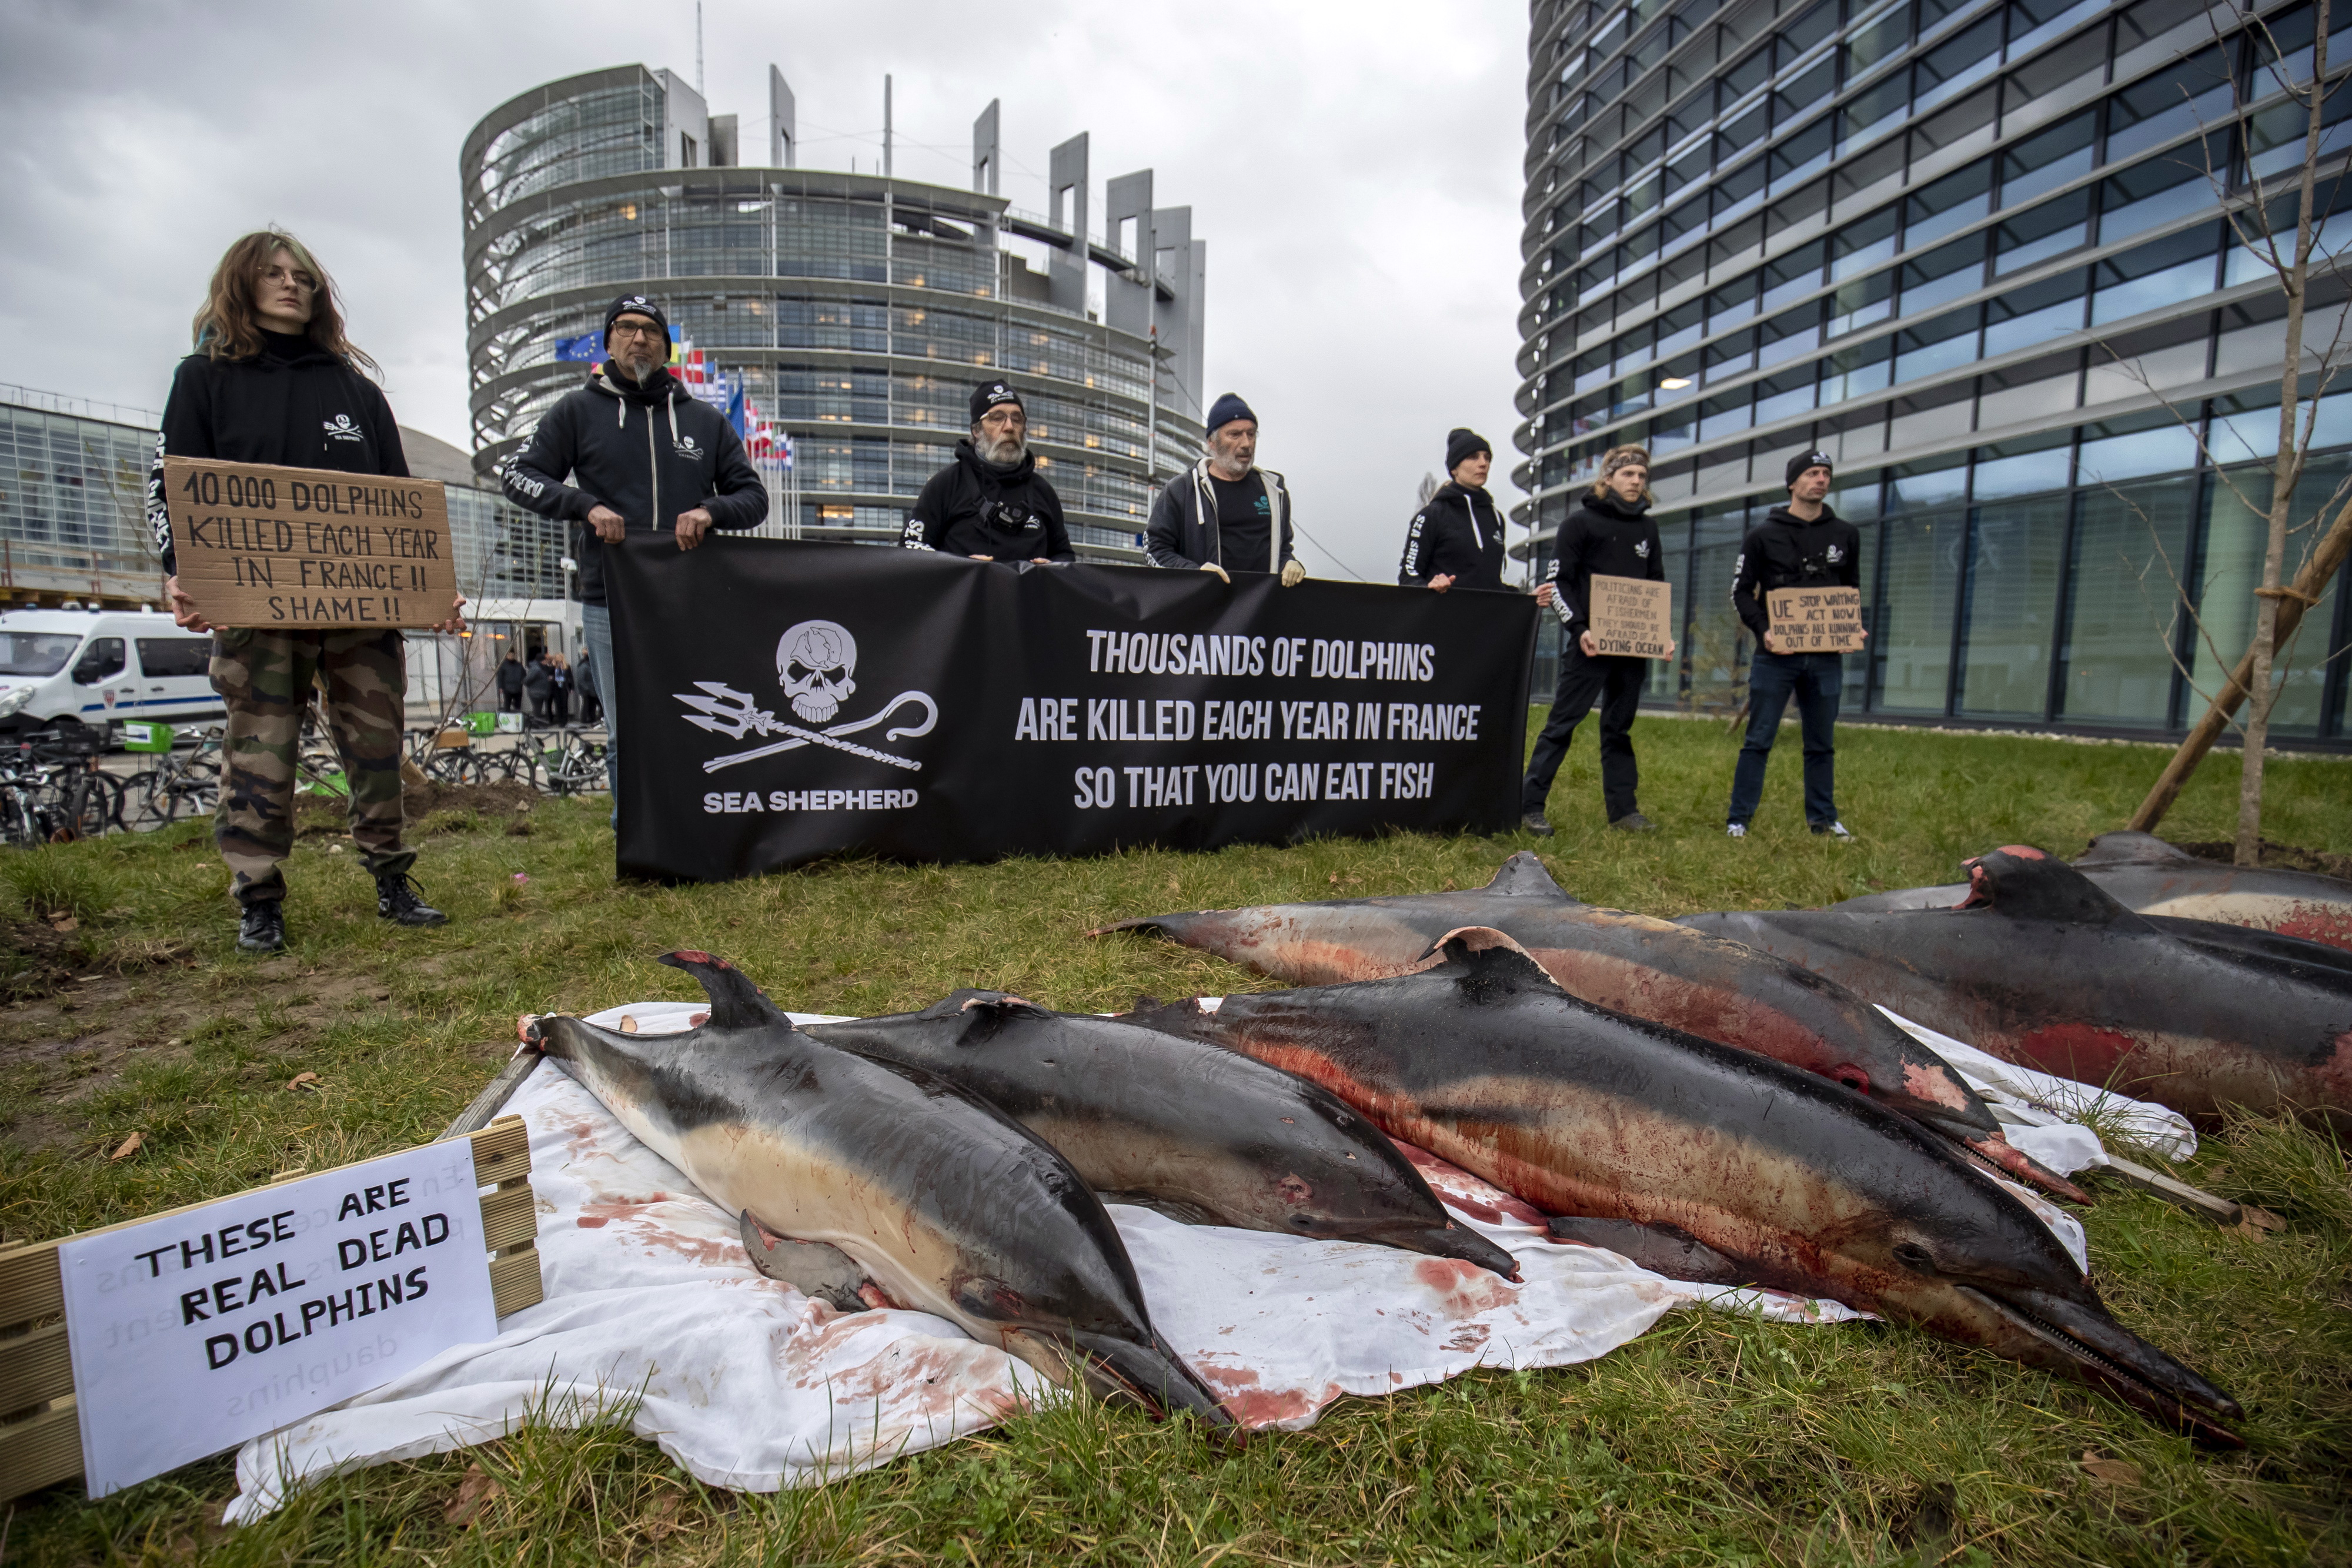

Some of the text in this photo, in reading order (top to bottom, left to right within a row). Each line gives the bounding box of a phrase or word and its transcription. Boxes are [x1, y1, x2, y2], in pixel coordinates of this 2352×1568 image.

[291, 482, 422, 519] DOLPHINS
[1411, 514, 1425, 537] SEA
[187, 516, 439, 560] KILLED EACH YEAR
[232, 557, 272, 589] IN
[1607, 594, 1652, 608] AFRAID OF
[1772, 600, 1793, 618] UE
[1800, 591, 1860, 607] STOP WAITING
[1596, 617, 1618, 627] THEY
[1608, 606, 1656, 620] FISHERMEN
[1806, 609, 1825, 620] ACT
[1606, 629, 1637, 640] AFRAID
[1774, 623, 1860, 636] DOLPHINS ARE RUNNING
[1786, 635, 1852, 647] OUT OF TIME
[1087, 630, 1435, 681] THOUSANDS OF DOLPHINS
[1599, 638, 1663, 656] DYING OCEAN
[1015, 698, 1481, 740] ARE KILLED EACH YEAR IN FRANCE
[1075, 763, 1434, 808] SO THAT YOU CAN EAT FISH
[704, 790, 917, 813] SEA SHEPHERD
[135, 1211, 295, 1276] THESE
[339, 1178, 409, 1221] ARE
[182, 1262, 305, 1325] REAL
[338, 1213, 449, 1270] DEAD
[205, 1266, 428, 1370] DOLPHINS
